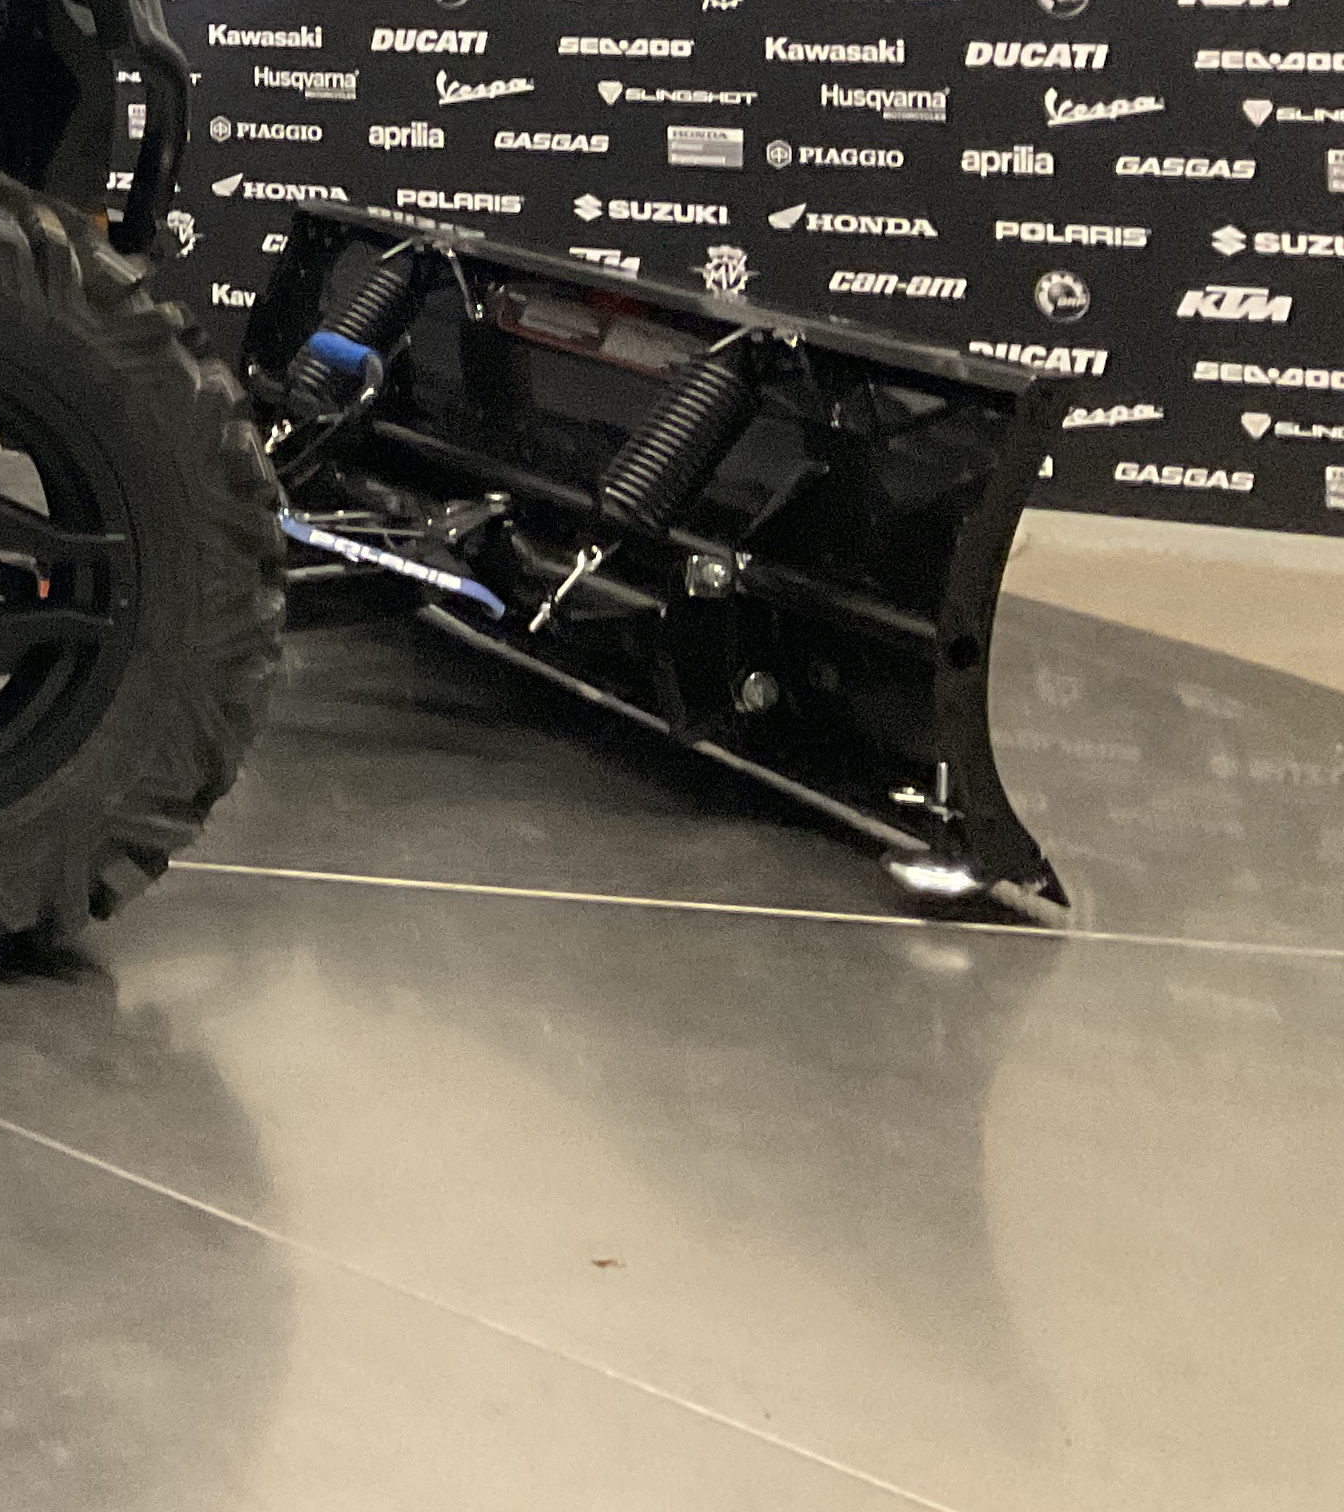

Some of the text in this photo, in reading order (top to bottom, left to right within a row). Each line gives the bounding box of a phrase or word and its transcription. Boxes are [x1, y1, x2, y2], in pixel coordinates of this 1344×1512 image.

[208, 23, 323, 49] Kawasaki
[370, 27, 489, 55] DUCATI
[764, 36, 905, 64] Kawasaki
[964, 40, 1109, 71] DUCATI
[254, 66, 357, 90] Husqvarna
[435, 69, 535, 106] Vespa
[624, 87, 758, 106] SLINGSHOT
[820, 84, 947, 111] Husqvarna
[1043, 86, 1165, 128] Vespa
[236, 121, 323, 142] PIAGGIO
[368, 120, 445, 151] aprilia
[494, 130, 610, 153] GASGAS
[798, 146, 905, 168] PIAGGIO
[960, 144, 1055, 179] aprilia
[1114, 155, 1257, 180] GASGAS
[242, 181, 350, 203] HONDA
[396, 189, 522, 214] POLARIS
[608, 199, 731, 226] SUZUKI
[805, 212, 939, 238] HONDA
[994, 220, 1147, 248] POLARIS
[828, 270, 968, 300] can-am
[1175, 284, 1293, 323] KTM
[1113, 461, 1255, 492] GASGAS
